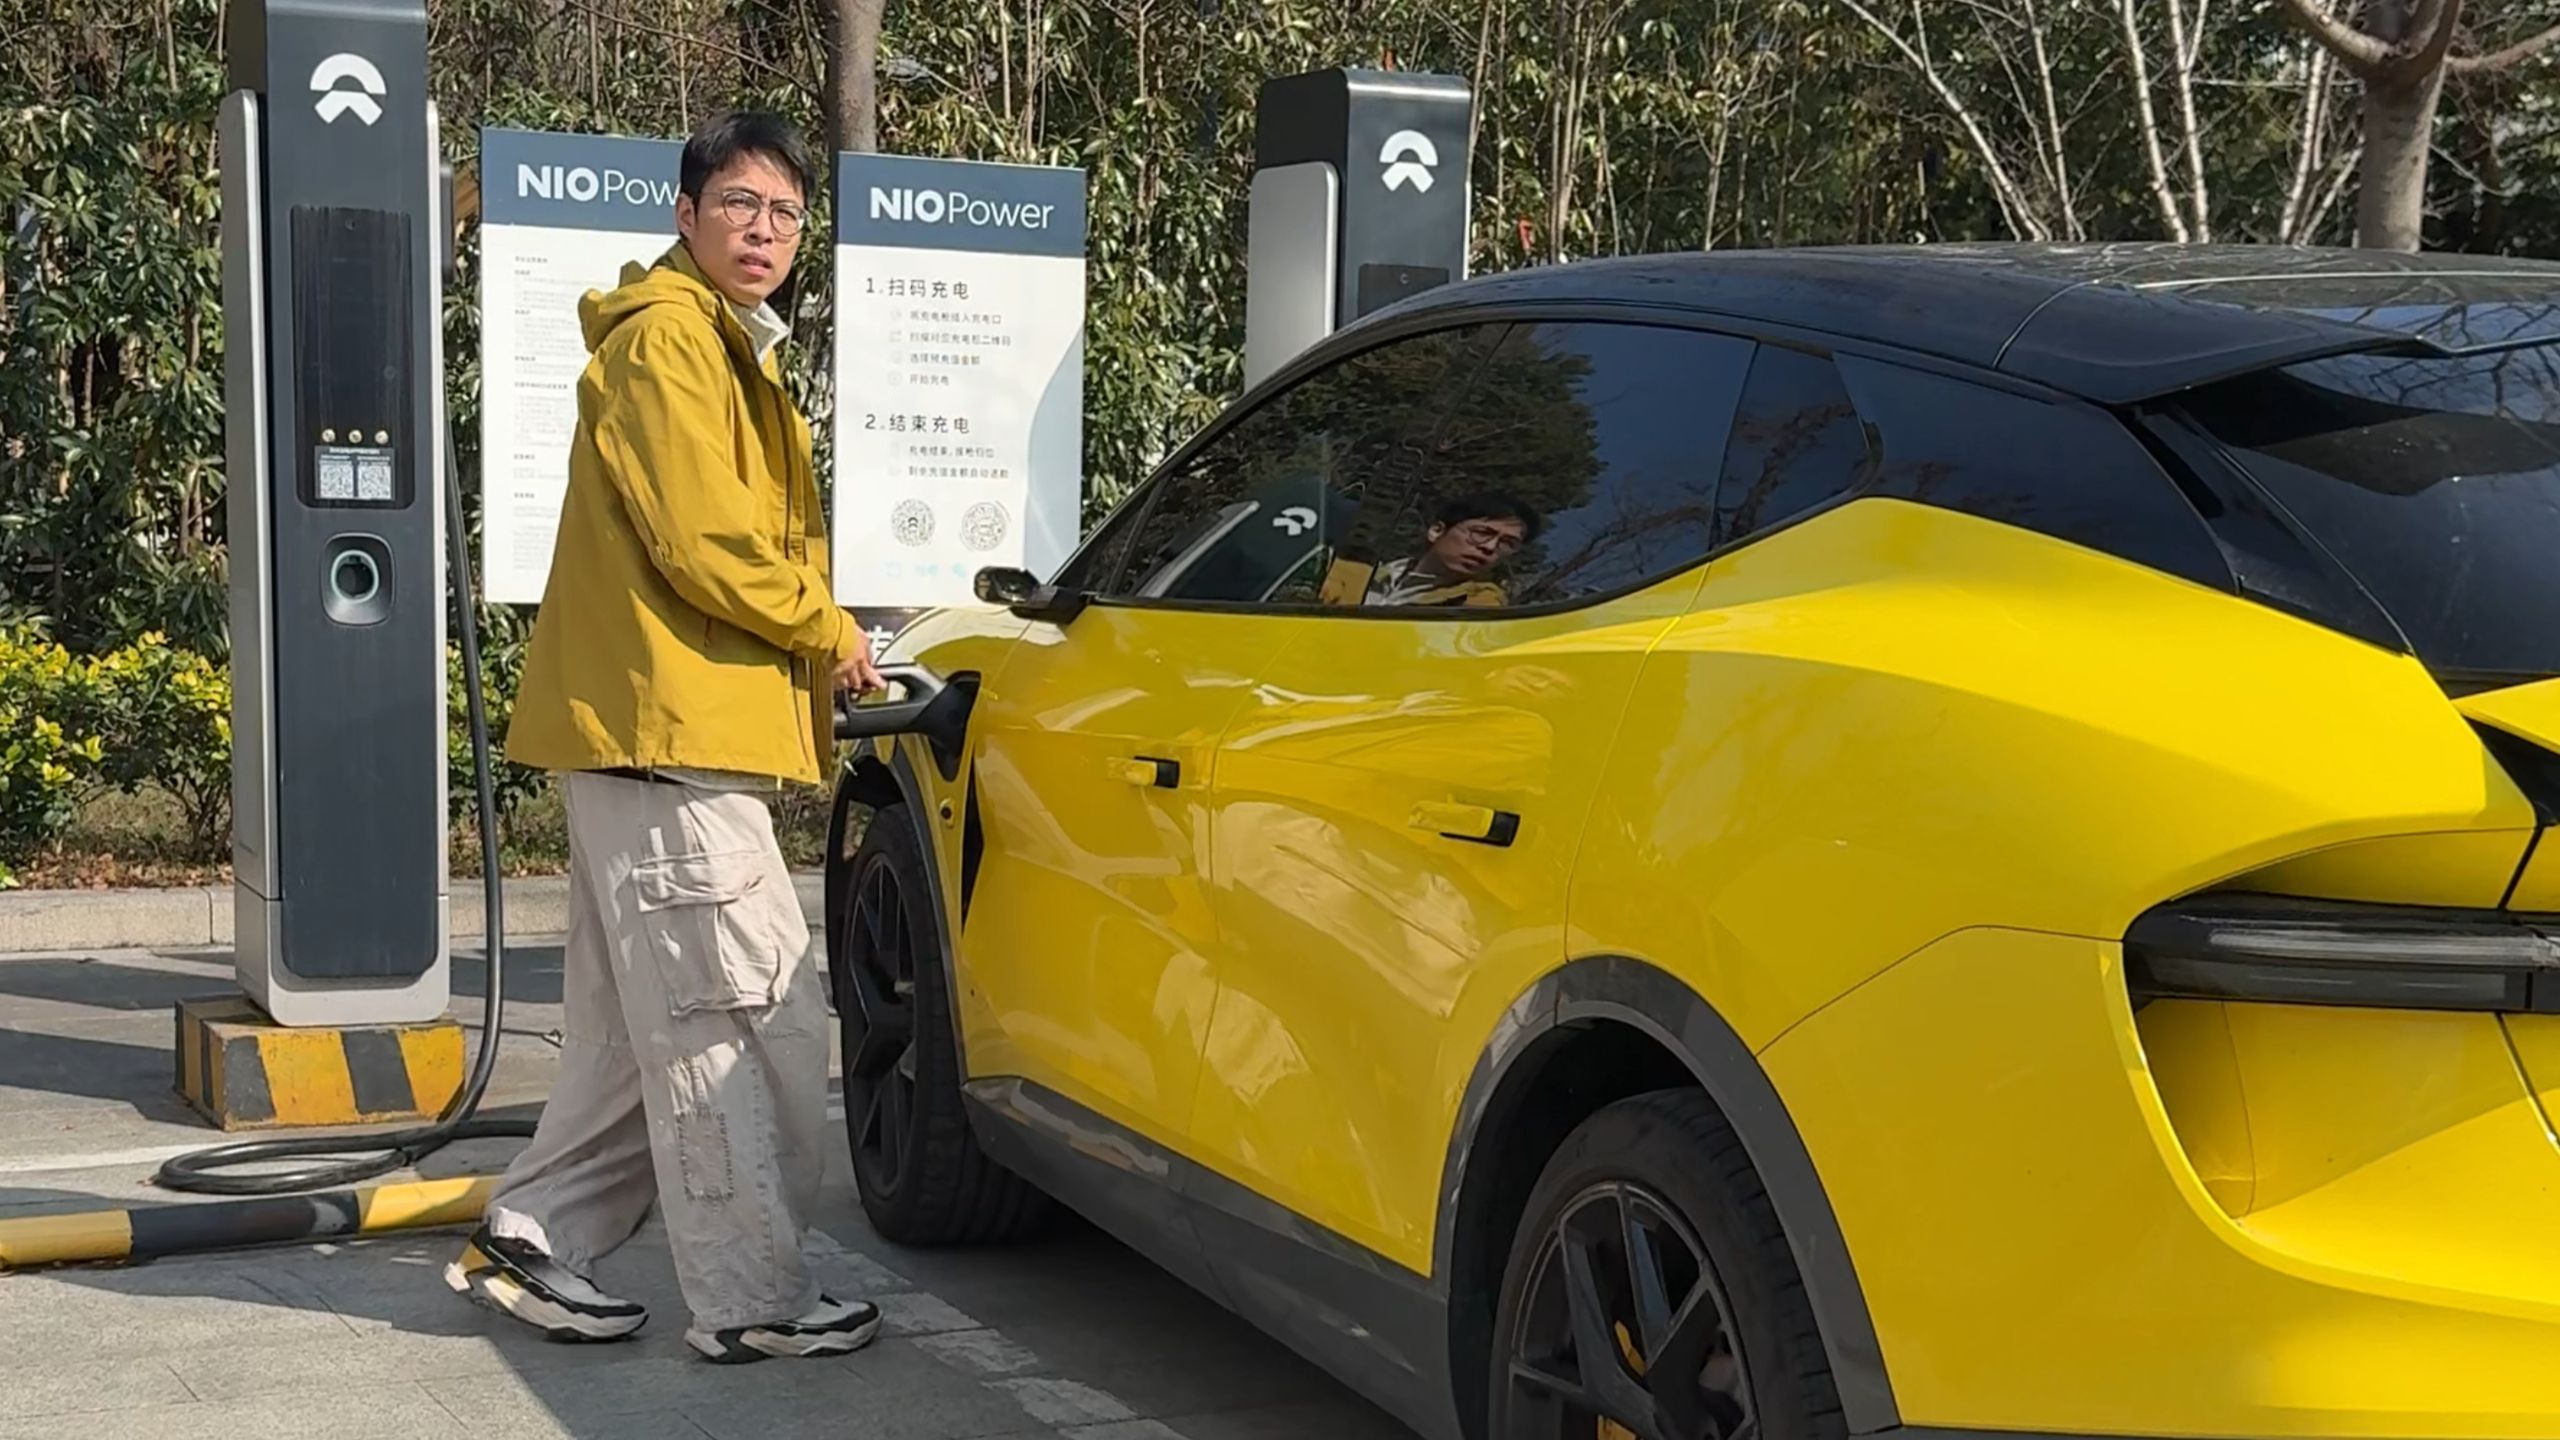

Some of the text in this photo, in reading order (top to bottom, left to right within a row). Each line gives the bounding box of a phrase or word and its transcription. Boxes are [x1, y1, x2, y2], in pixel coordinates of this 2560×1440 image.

[517, 163, 681, 206] NIOPow
[865, 277, 970, 300] 1.扫码充电
[864, 413, 970, 434] 2.结束充电
